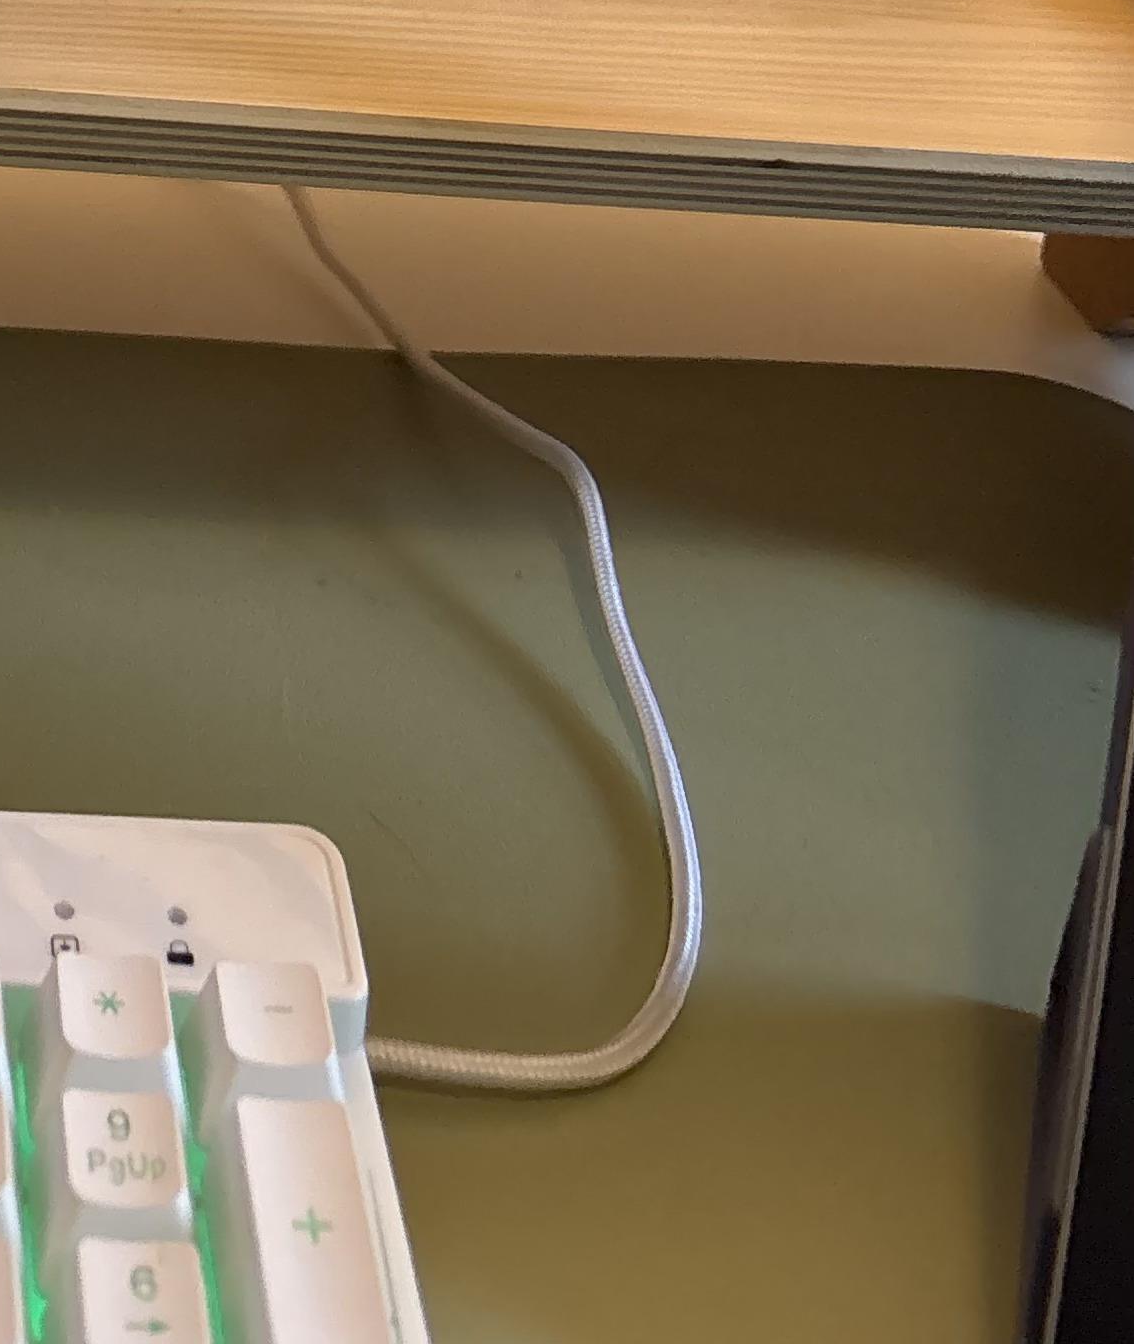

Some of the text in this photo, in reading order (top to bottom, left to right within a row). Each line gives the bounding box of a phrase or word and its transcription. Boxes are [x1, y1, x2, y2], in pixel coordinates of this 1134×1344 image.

[106, 1108, 131, 1142] 9
[87, 1148, 165, 1187] PgUp
[130, 1263, 158, 1301] 6
